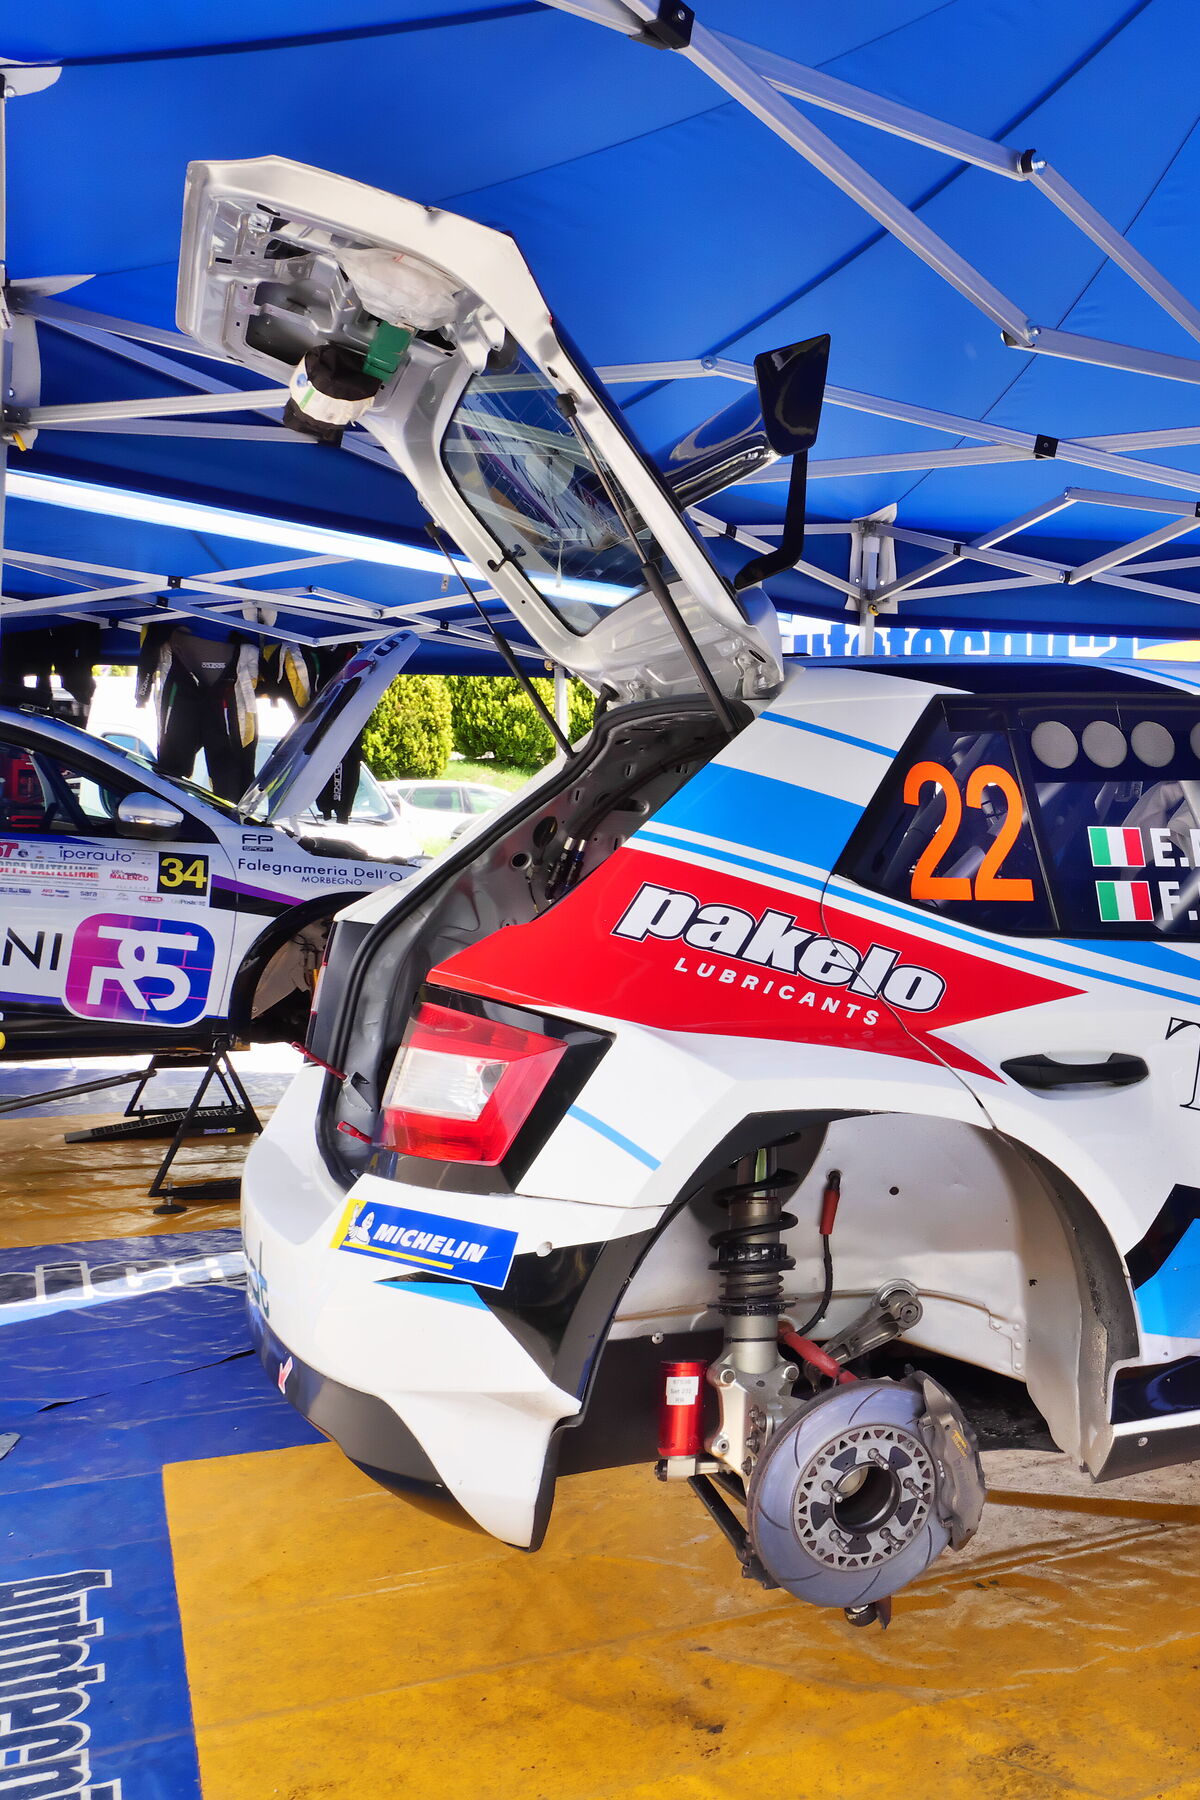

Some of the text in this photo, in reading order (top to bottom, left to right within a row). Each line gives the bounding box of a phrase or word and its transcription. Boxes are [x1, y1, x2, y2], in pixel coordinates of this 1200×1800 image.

[242, 834, 273, 844] FP
[903, 761, 1035, 901] 22
[59, 845, 132, 863] iperauto
[238, 858, 406, 882] Falegnameria Dell'O
[159, 857, 207, 889] 34
[301, 876, 363, 886] MORBEGNO
[610, 881, 947, 1013] pakelo
[673, 957, 880, 1026] LUBRICANTS
[372, 1223, 489, 1263] MICHELIN
